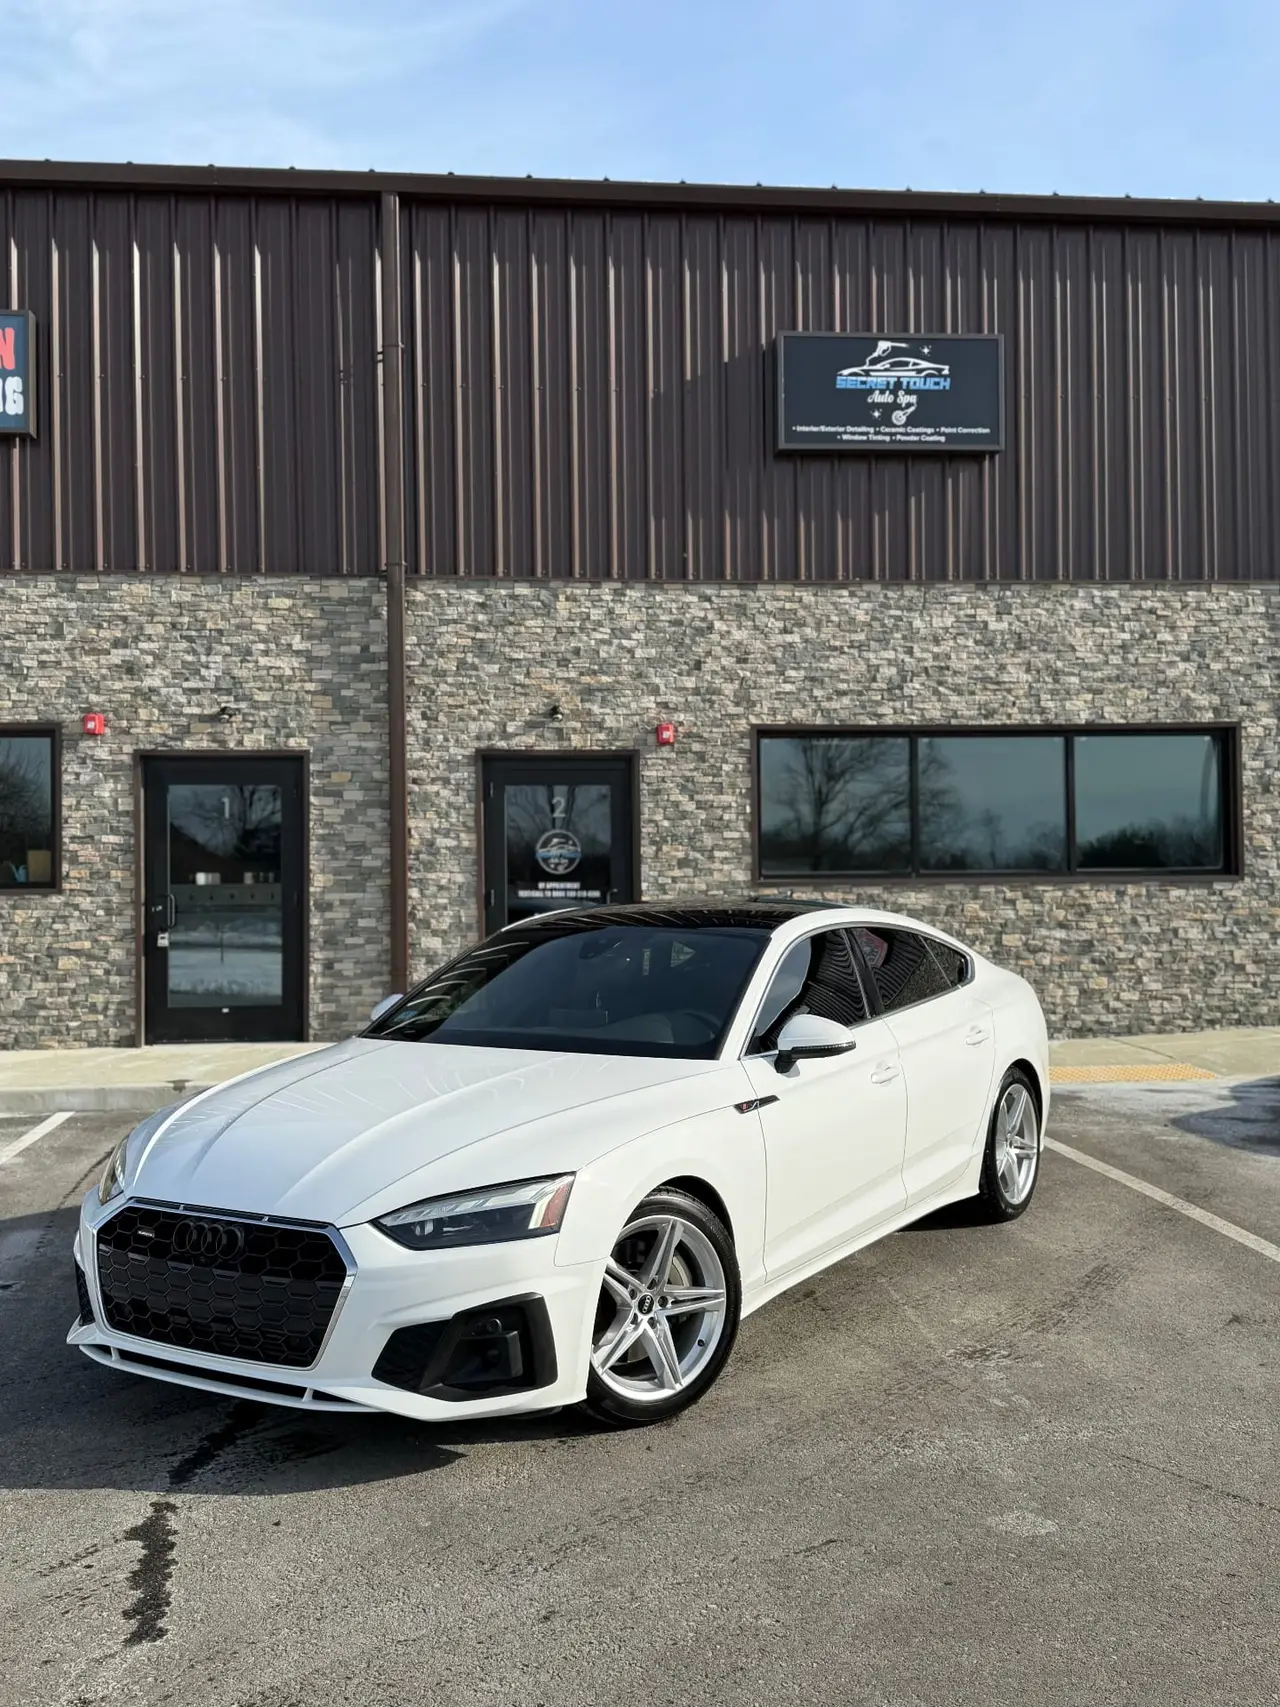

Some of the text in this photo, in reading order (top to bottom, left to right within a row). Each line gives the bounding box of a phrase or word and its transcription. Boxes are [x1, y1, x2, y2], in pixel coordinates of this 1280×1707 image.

[836, 375, 951, 390] SECRET TOUCH
[0, 376, 24, 415] G
[867, 390, 918, 407] Auto Spa
[796, 425, 845, 433] Interior/Exterior
[846, 426, 875, 434] Detailing
[907, 426, 935, 434] Coatings
[868, 434, 891, 442] Tinting
[920, 435, 946, 443] Coating
[221, 796, 230, 819] 1
[552, 796, 566, 818] 2
